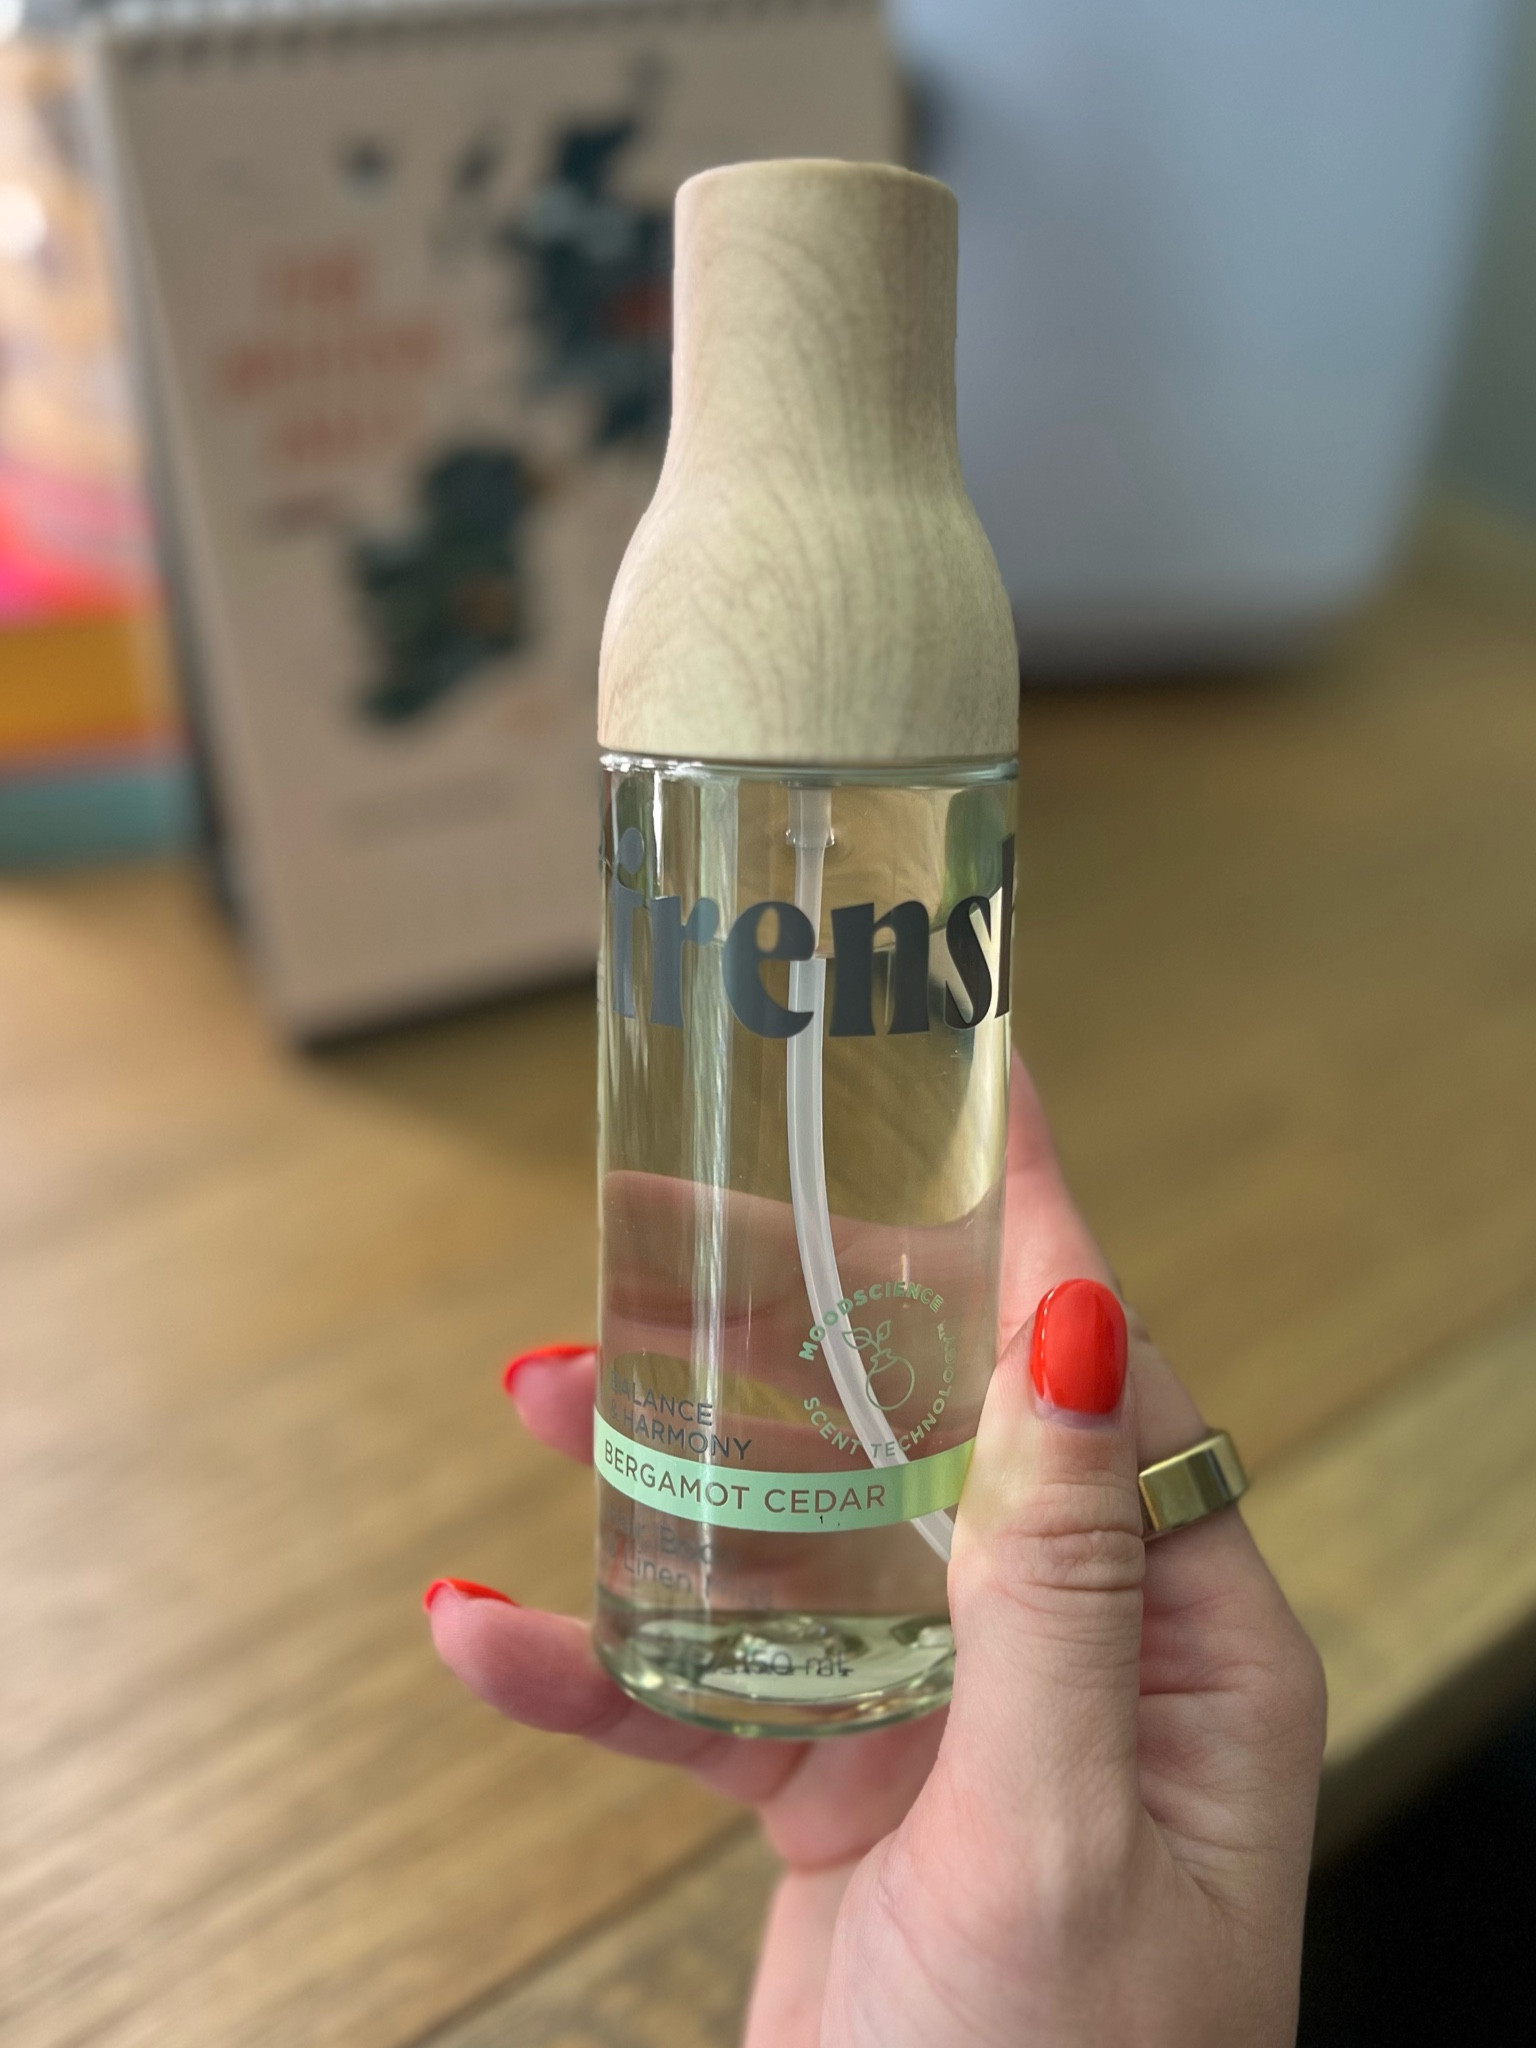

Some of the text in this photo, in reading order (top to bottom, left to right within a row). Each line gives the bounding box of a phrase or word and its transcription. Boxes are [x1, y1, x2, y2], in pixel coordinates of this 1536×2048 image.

[798, 1280, 944, 1361] MOODSCIENCE
[610, 1369, 713, 1427] BALANCE
[803, 1396, 865, 1456] SCENT
[623, 1407, 752, 1461] HARMONY
[604, 1438, 887, 1514] BERGAMOT CEDAR
